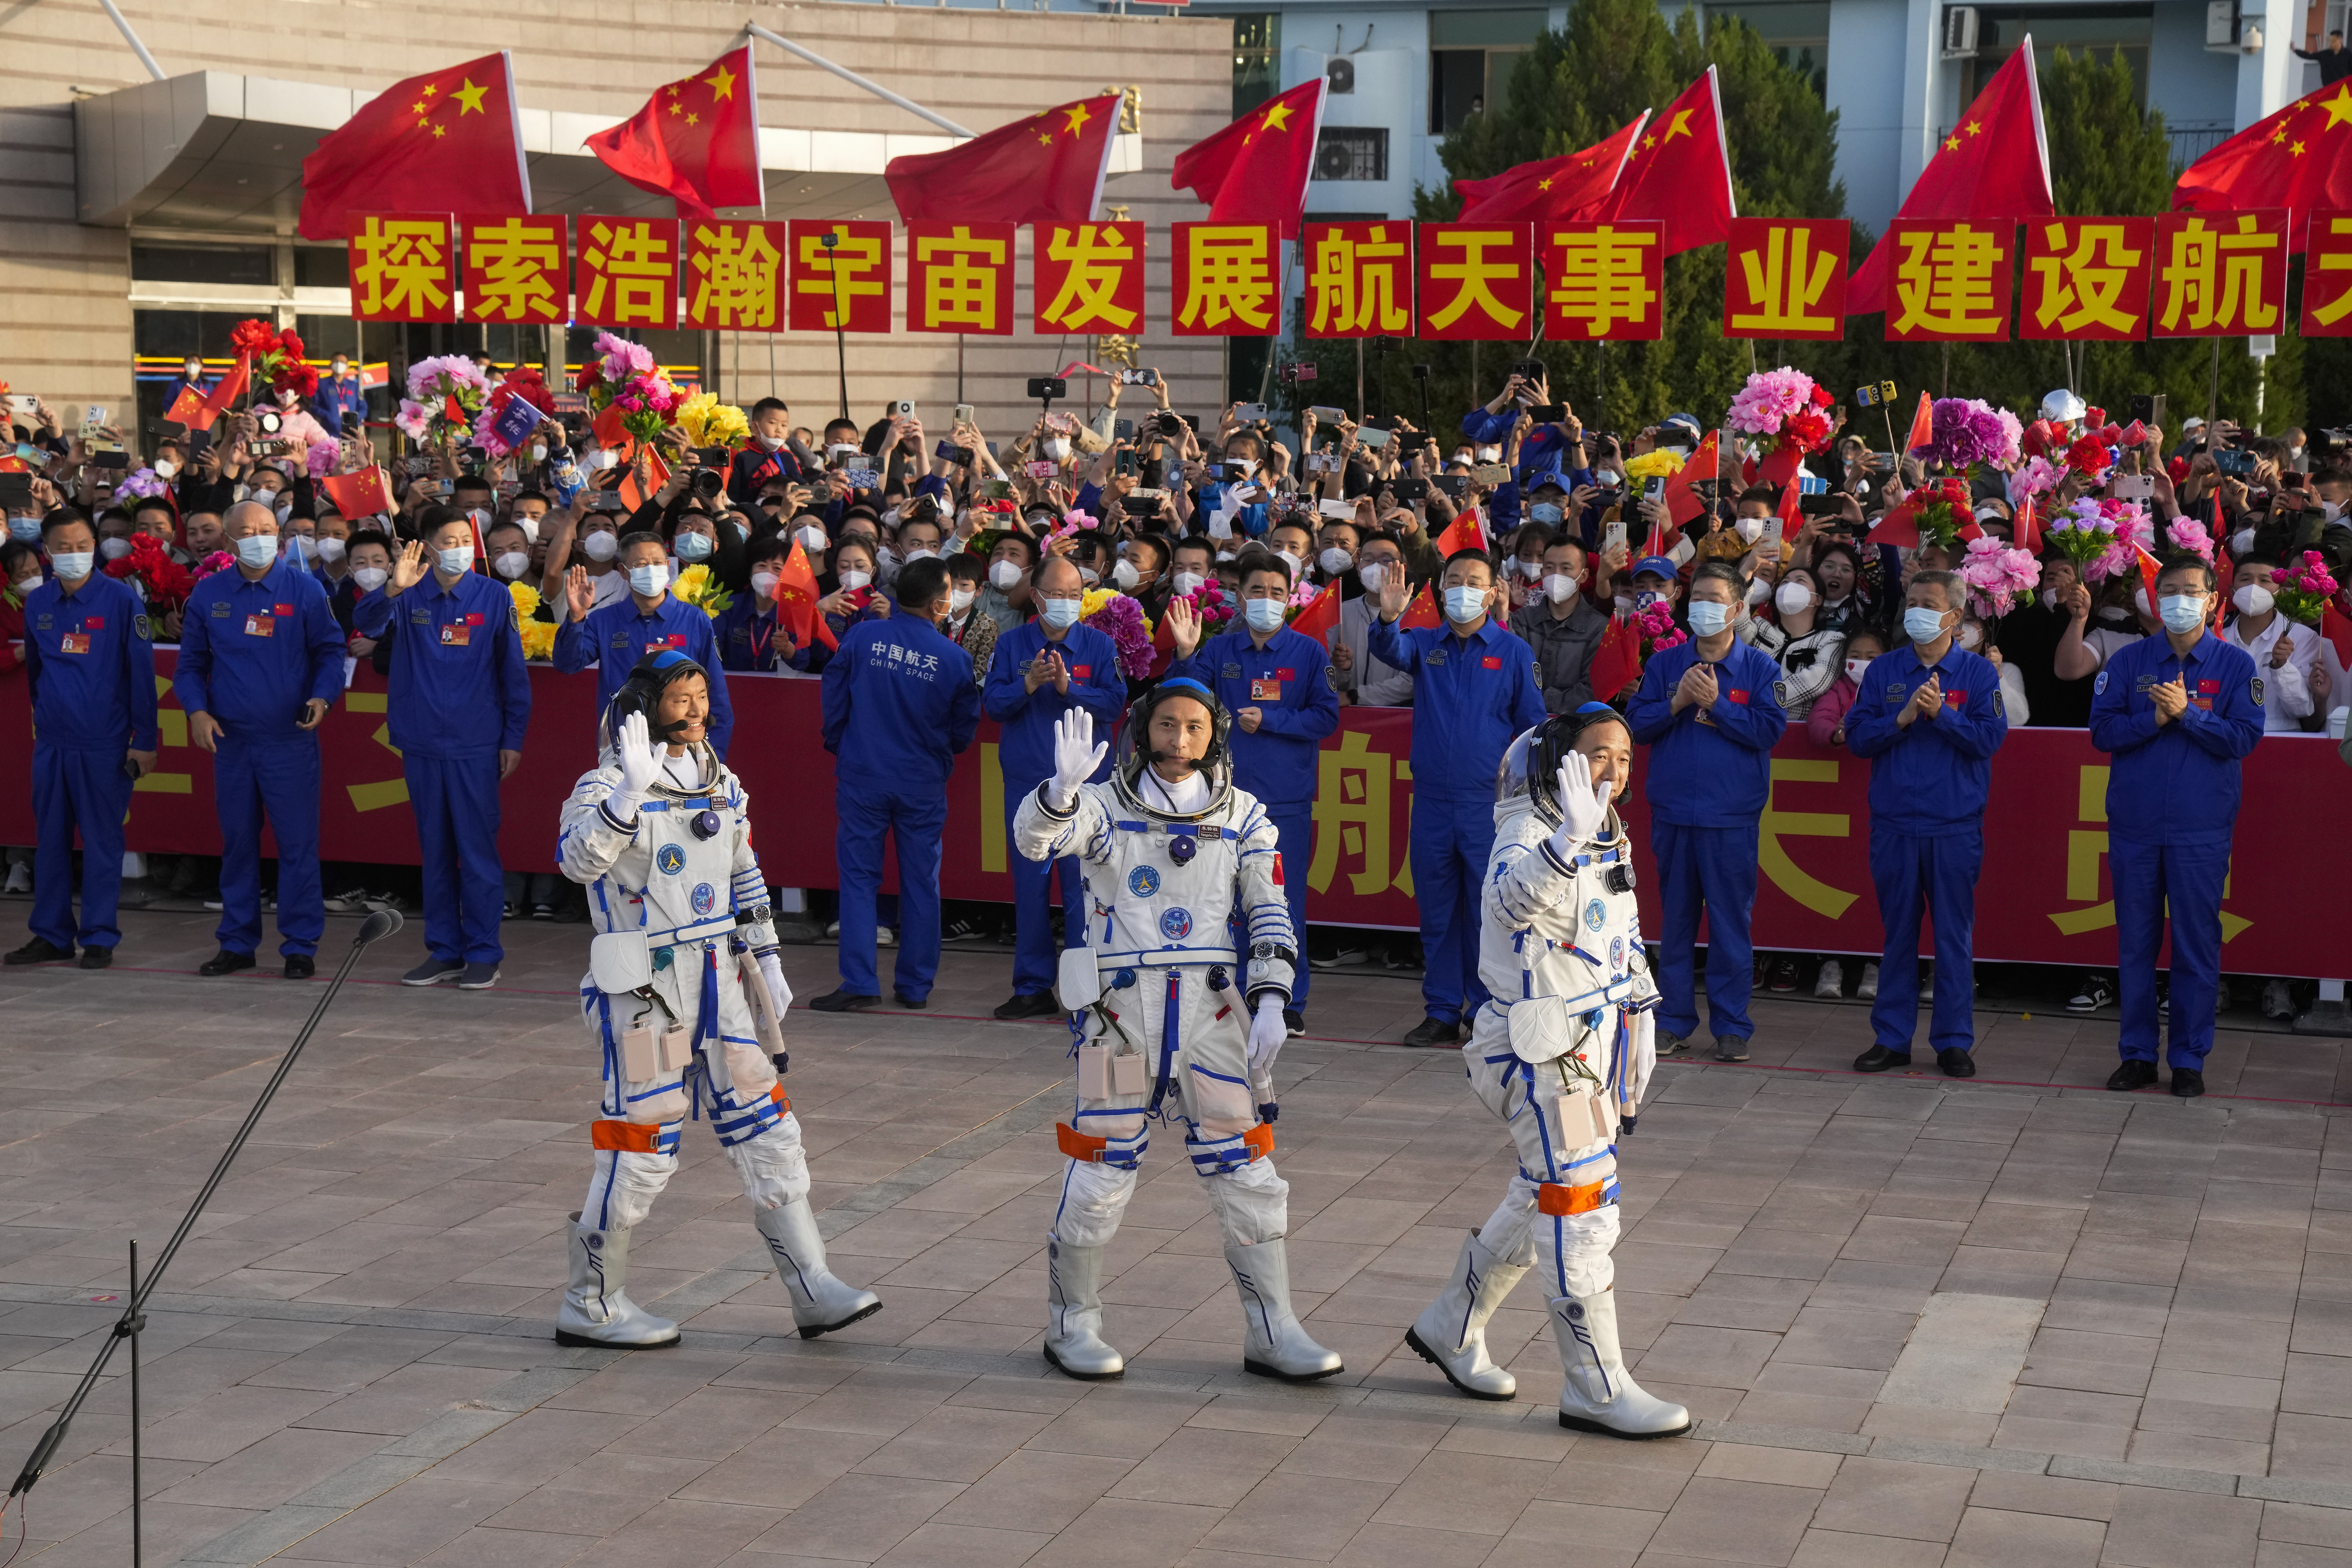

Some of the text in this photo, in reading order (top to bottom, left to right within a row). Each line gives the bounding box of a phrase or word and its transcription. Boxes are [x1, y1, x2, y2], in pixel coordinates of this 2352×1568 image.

[871, 641, 938, 671] 中国航天
[871, 658, 935, 682] CHINA SPACE
